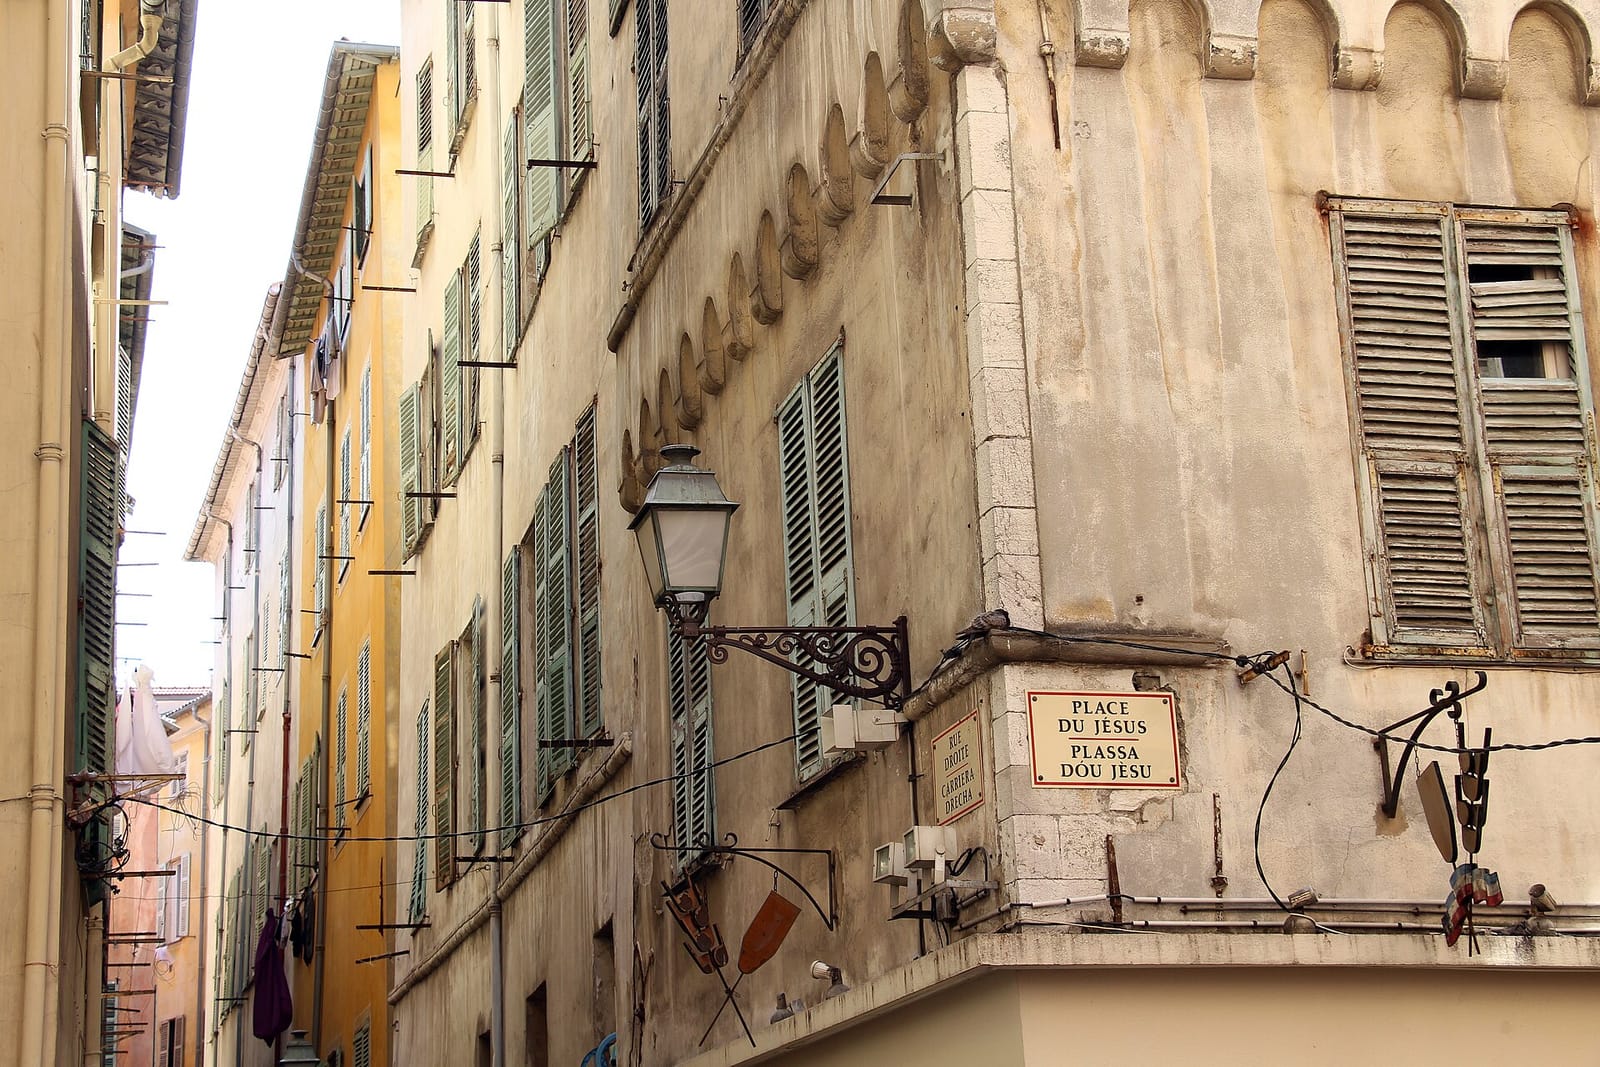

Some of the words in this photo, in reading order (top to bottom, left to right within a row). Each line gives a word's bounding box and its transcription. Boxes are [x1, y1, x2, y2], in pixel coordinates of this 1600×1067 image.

[1072, 701, 1130, 715] PLACE
[1058, 719, 1084, 733] DU
[1094, 717, 1147, 735] JÉSUS
[949, 731, 962, 749] RUE
[944, 744, 969, 771] DROITE
[1071, 745, 1139, 760] PLASSA
[1060, 761, 1101, 778] DÓU
[1111, 762, 1152, 780] JÈSU
[941, 768, 975, 798] CARRIERA
[945, 787, 973, 814] DRECHA
